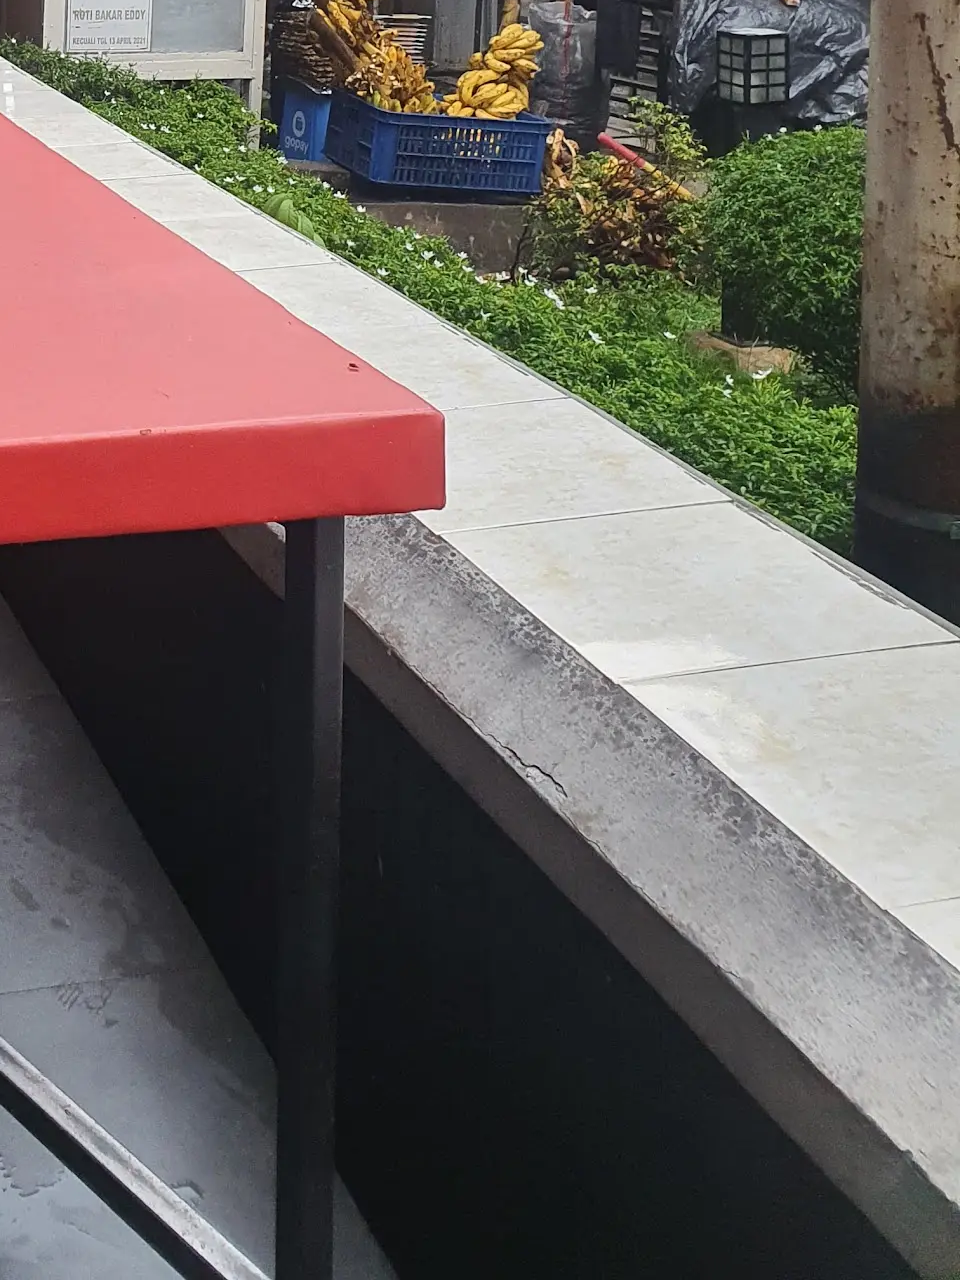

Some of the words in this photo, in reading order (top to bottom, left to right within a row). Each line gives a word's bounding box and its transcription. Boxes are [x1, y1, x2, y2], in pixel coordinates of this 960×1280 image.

[73, 9, 93, 21] ROTI
[95, 9, 123, 21] BAKAR
[124, 9, 146, 21] EDDY
[284, 136, 310, 155] gopay
